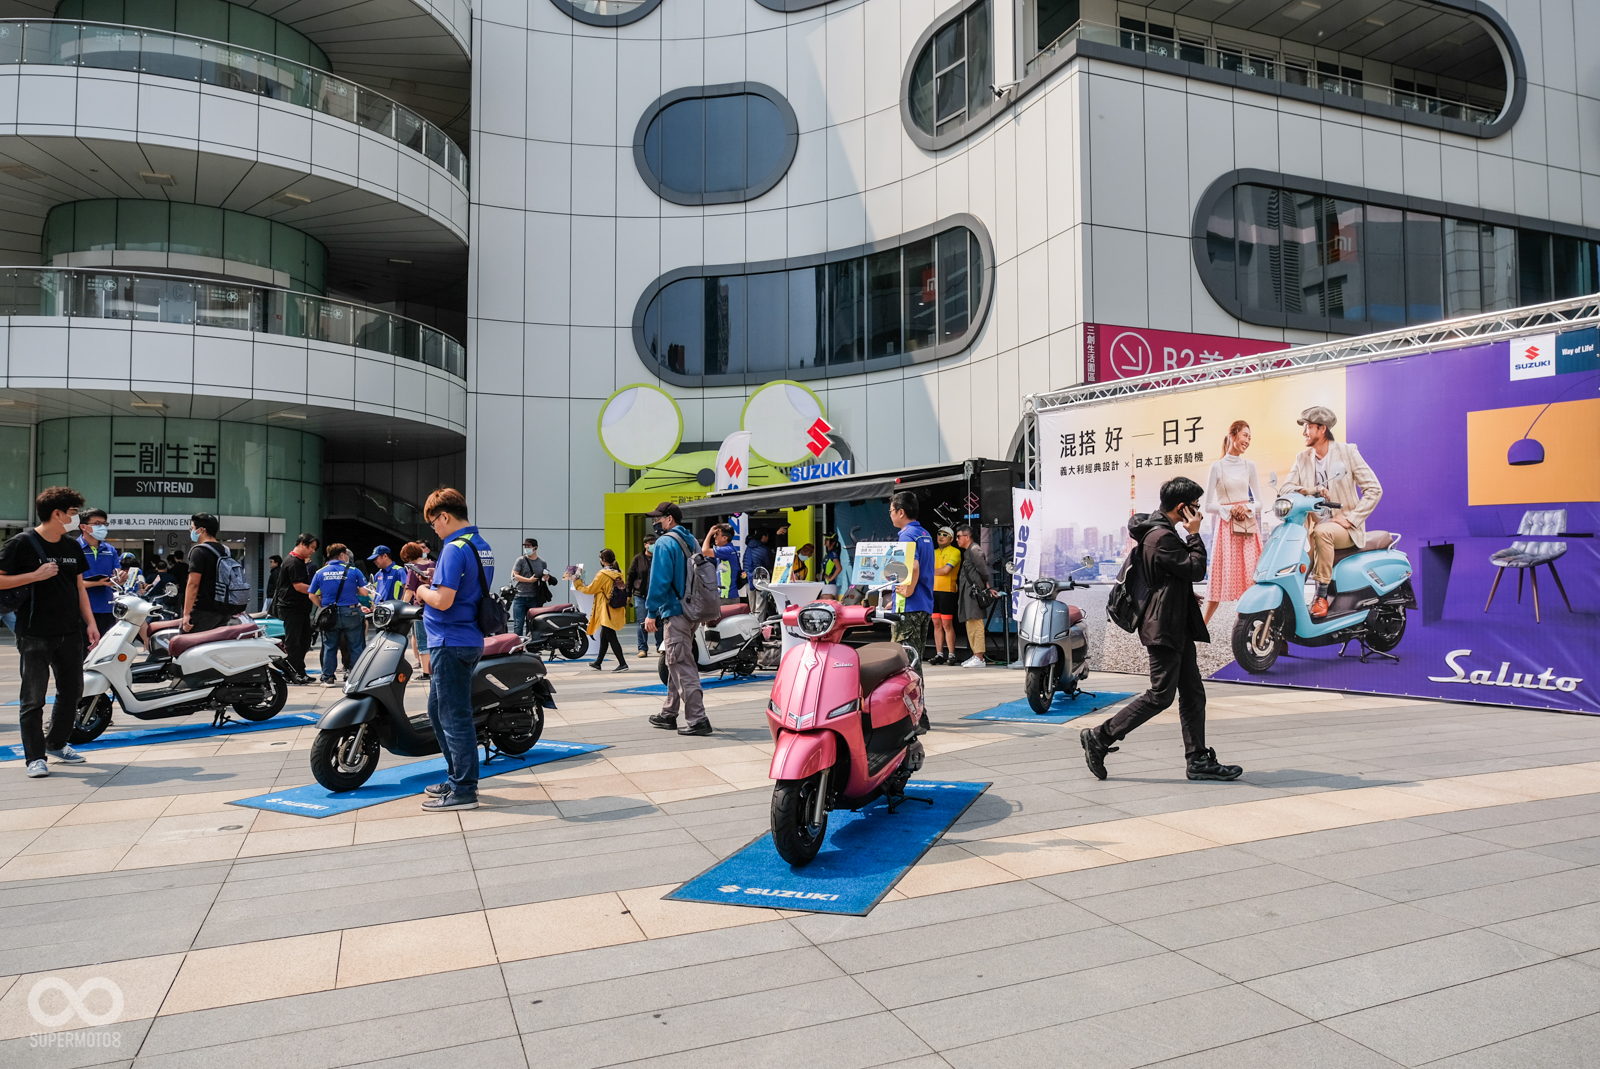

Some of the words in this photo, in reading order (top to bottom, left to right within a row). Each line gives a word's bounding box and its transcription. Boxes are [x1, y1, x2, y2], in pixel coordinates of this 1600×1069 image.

[1562, 348, 1574, 356] Way
[1582, 344, 1594, 352] Life!
[1515, 360, 1551, 370] SUZUKI
[1060, 429, 1096, 459] 混搭
[1105, 427, 1123, 453] 好
[1163, 416, 1204, 446] 日子
[114, 442, 216, 475] 三創生活
[1060, 460, 1120, 476] 義大利經典設計
[1135, 451, 1204, 469] 日本工藝新騎機
[790, 460, 849, 482] SUZUKI
[136, 481, 194, 493] SYNTREND
[110, 518, 145, 526] 停車場入口
[148, 518, 178, 526] PARKING
[1428, 649, 1583, 692] Saluto
[744, 888, 840, 901] SUZUKI
